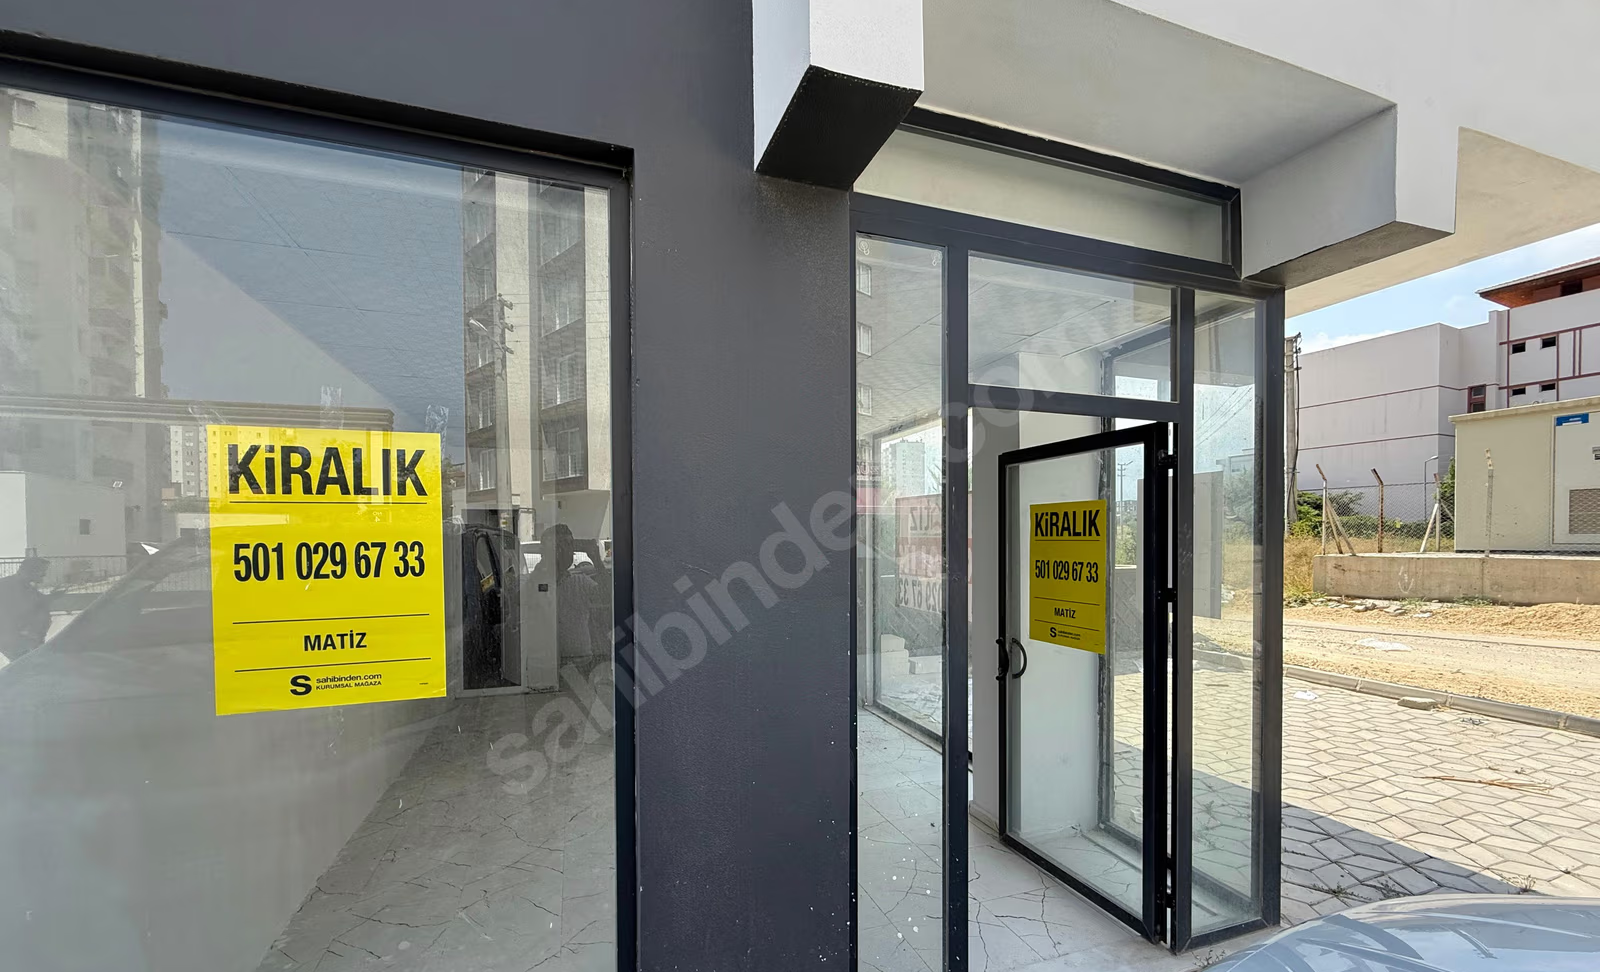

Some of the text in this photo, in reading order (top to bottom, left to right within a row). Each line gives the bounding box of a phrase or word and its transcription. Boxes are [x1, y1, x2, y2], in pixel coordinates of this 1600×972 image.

[233, 540, 426, 582] 501 029 67 33
[1035, 559, 1099, 583] 501 029 67 33
[1054, 606, 1076, 619] MATİZ
[303, 629, 367, 652] MATİZ
[289, 675, 312, 696] S
[315, 673, 382, 684] sahibinden.com
[315, 682, 353, 691] KURUMSAL
